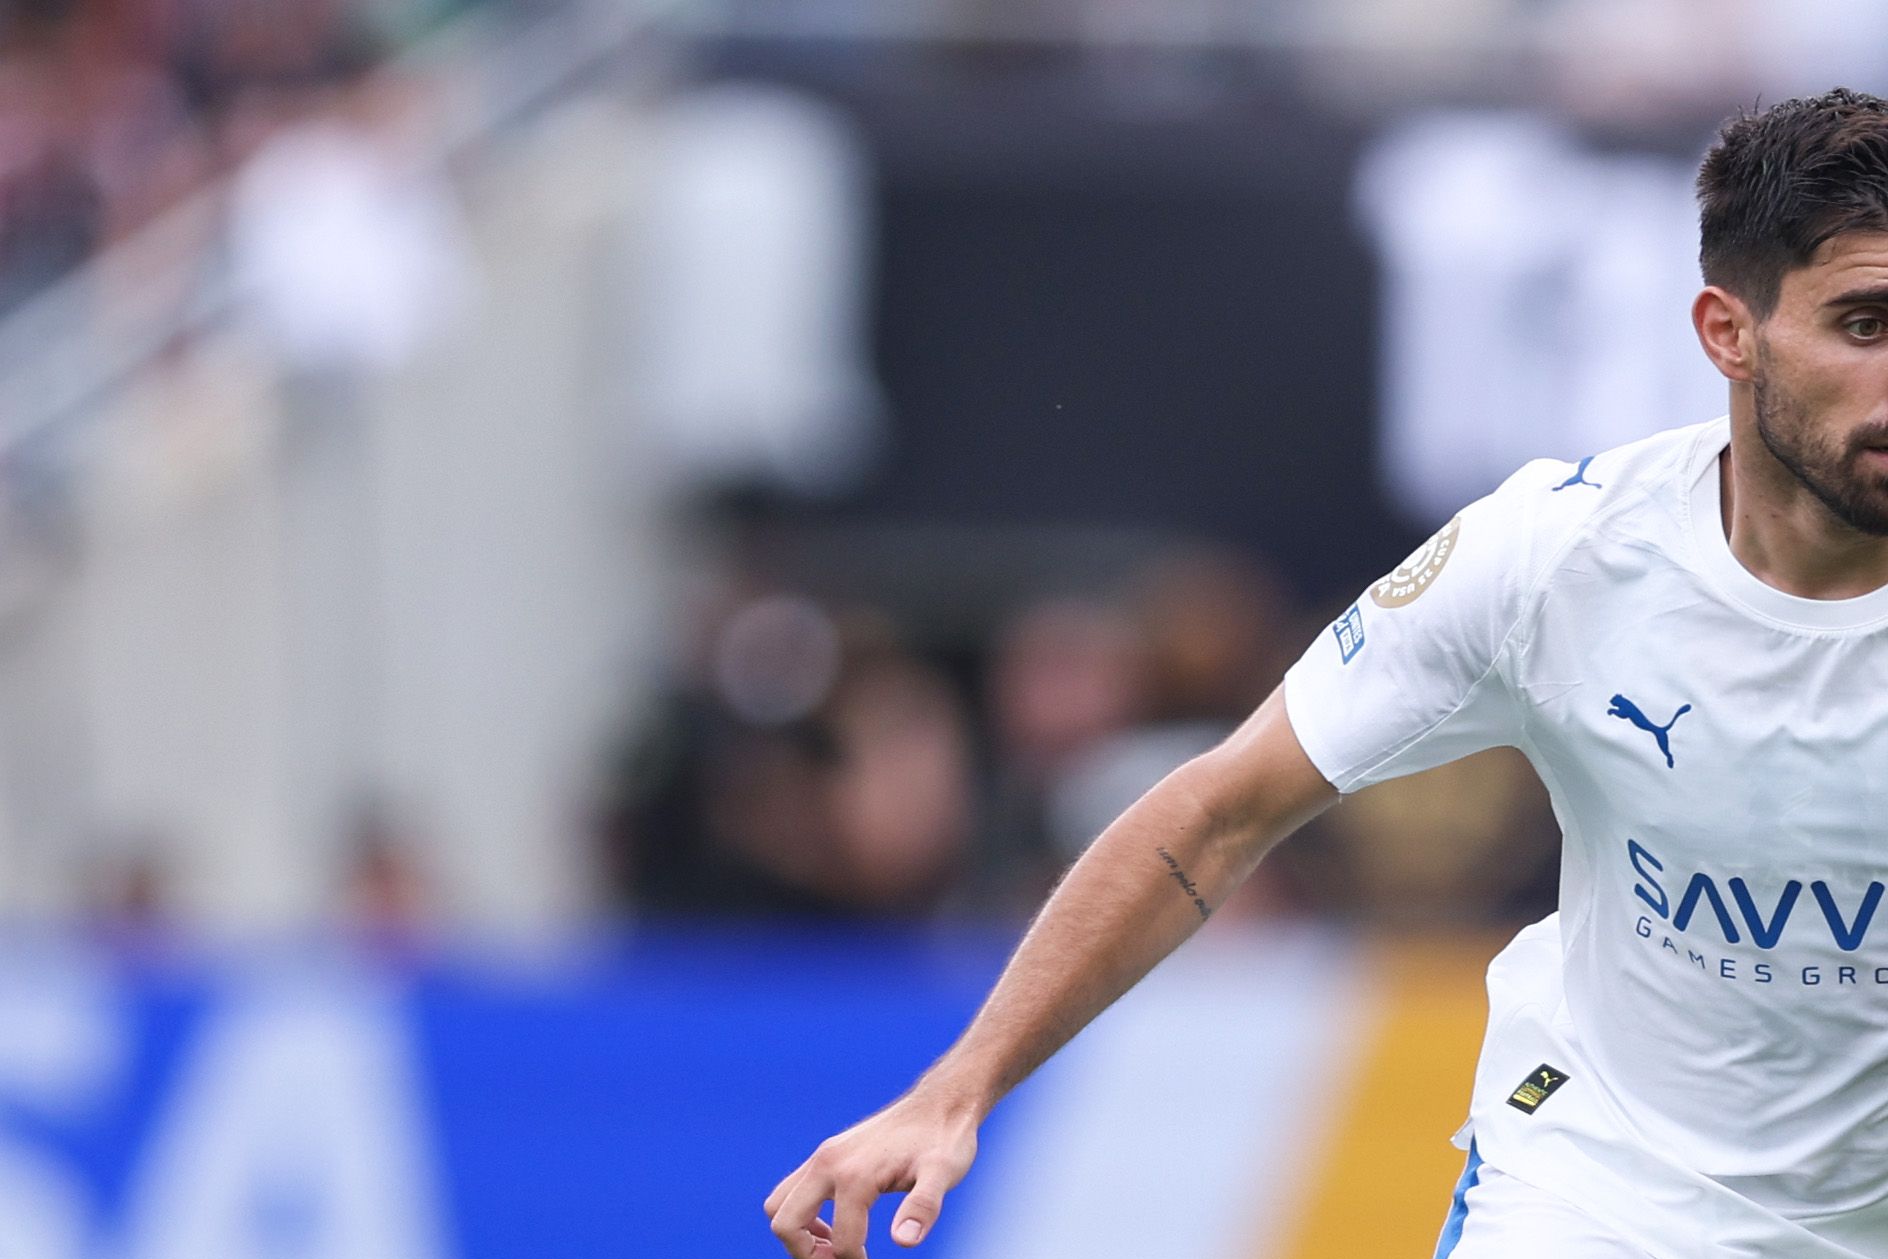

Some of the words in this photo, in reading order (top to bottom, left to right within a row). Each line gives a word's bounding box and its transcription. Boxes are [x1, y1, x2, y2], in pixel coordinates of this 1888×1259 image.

[1434, 539, 1450, 566] CUP
[1392, 583, 1415, 597] USA
[1636, 916, 1772, 983] GAMES
